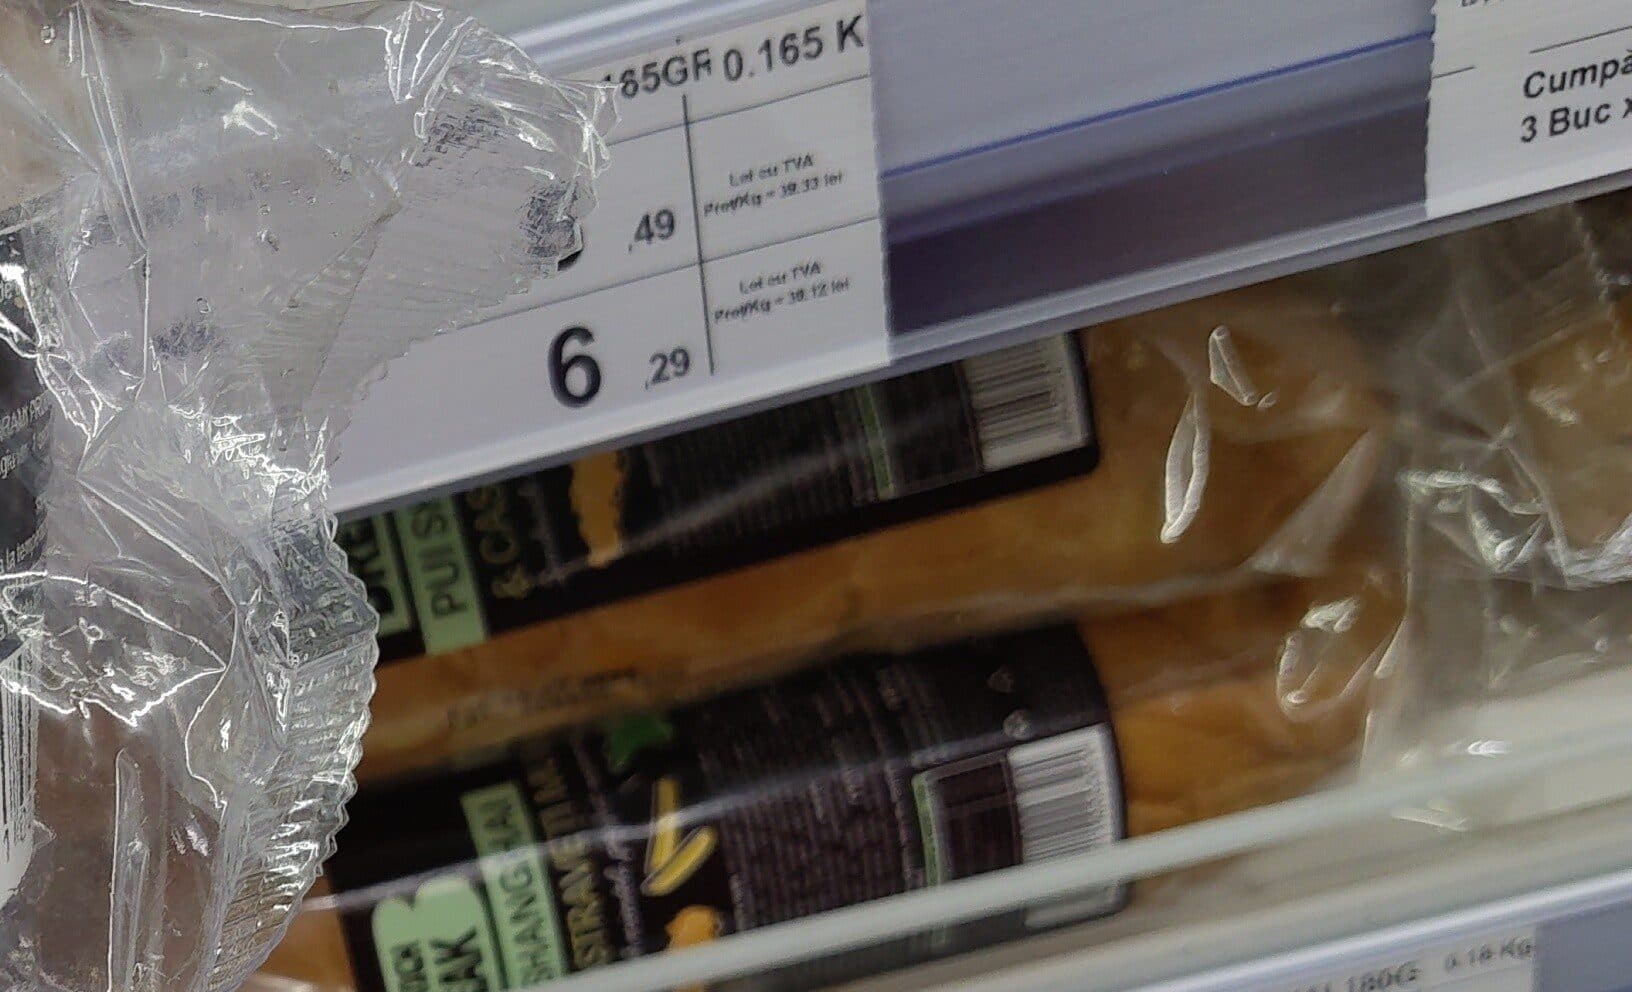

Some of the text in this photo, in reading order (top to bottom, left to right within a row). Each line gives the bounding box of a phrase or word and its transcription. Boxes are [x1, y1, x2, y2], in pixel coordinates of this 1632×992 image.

[722, 24, 824, 82] 0.165
[835, 13, 865, 52] K
[1521, 115, 1538, 143] 3
[1549, 101, 1612, 137] Buc
[547, 326, 601, 409] 6
